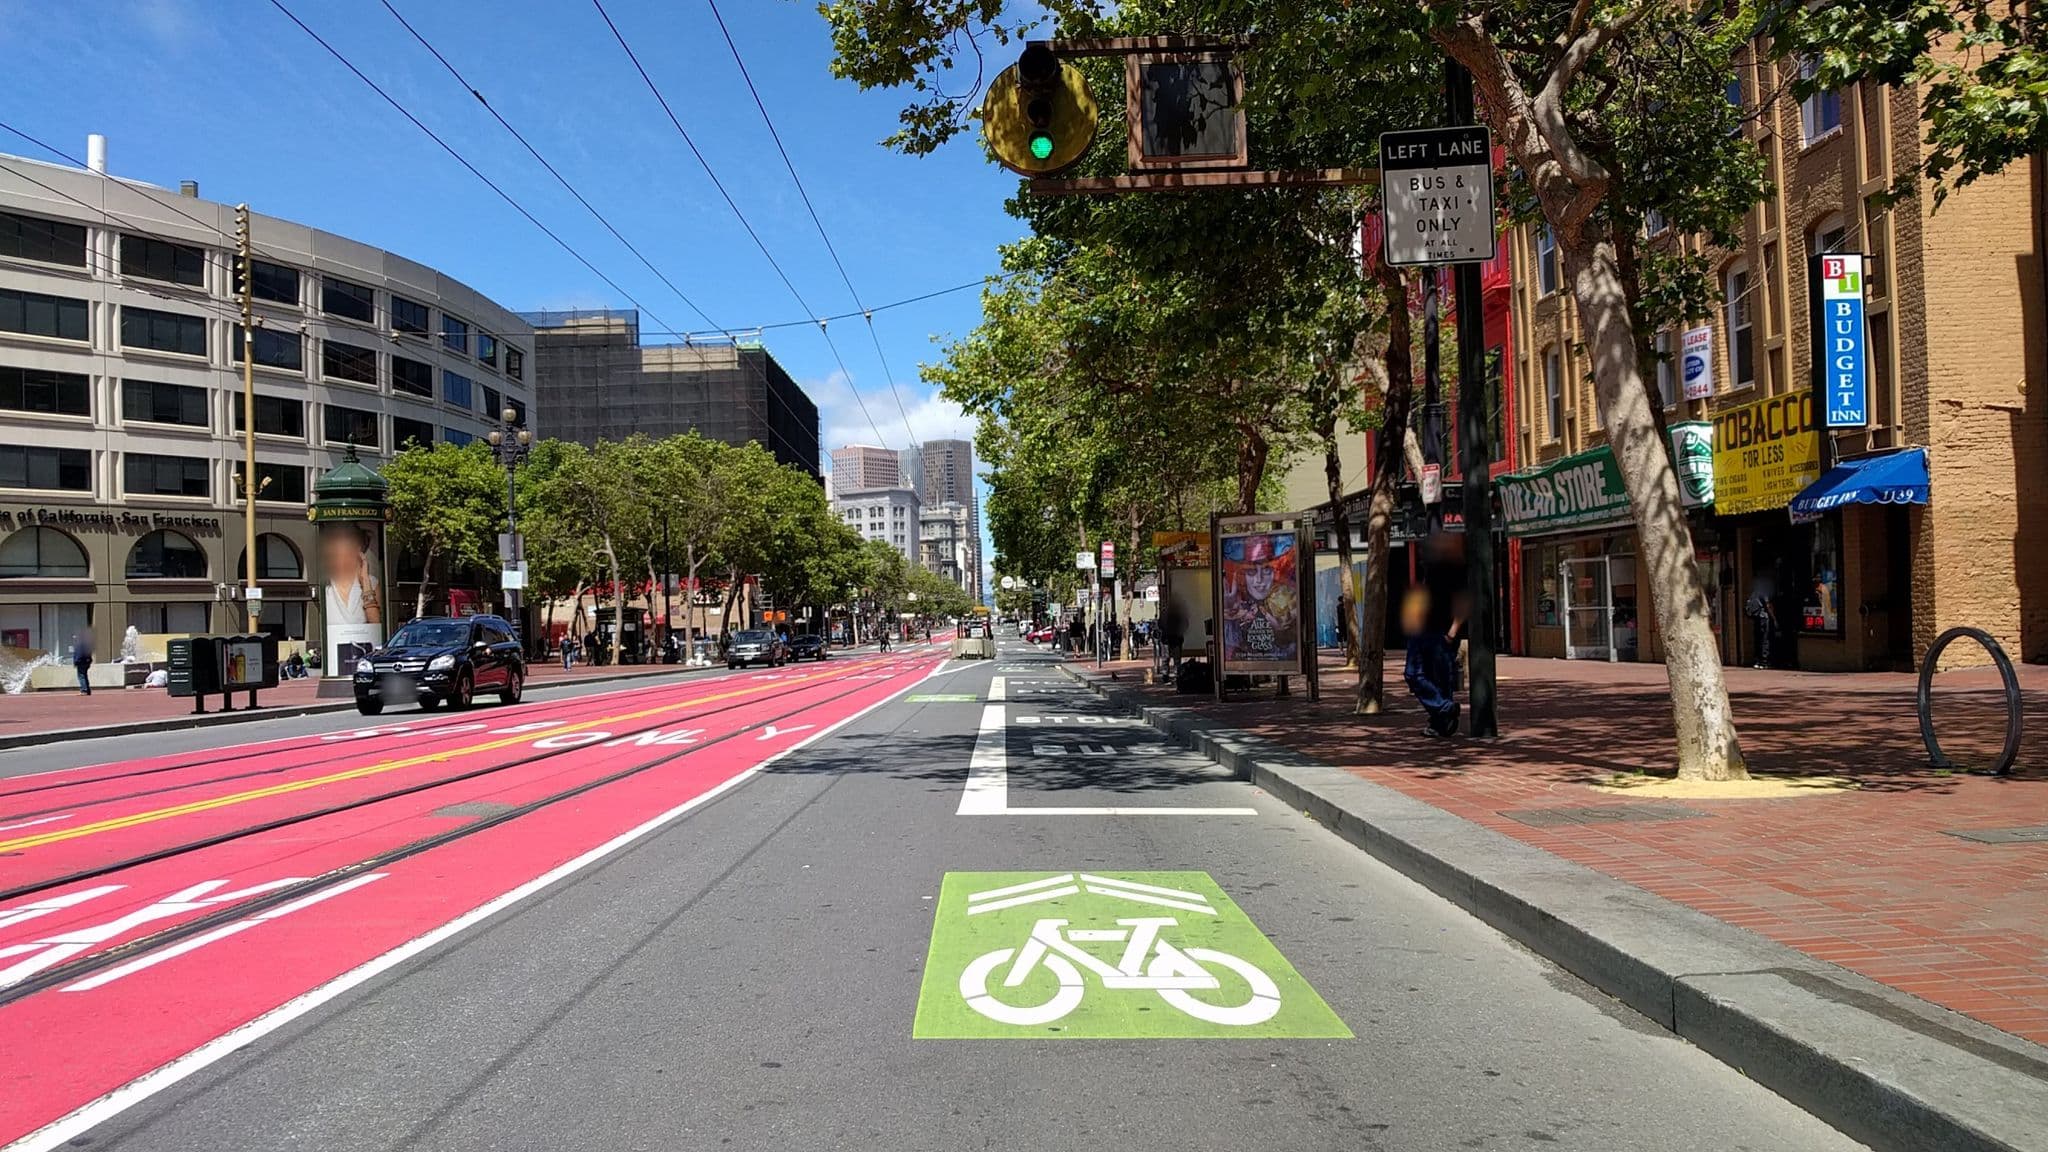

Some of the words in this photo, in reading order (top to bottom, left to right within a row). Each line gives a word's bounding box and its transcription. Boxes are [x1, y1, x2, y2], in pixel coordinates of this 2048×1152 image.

[1387, 143, 1428, 160] LEFT
[1438, 139, 1484, 157] LANE
[1409, 176, 1446, 191] BUS
[1455, 174, 1465, 188] &
[1419, 195, 1460, 212] TAXI
[1416, 217, 1462, 233] ONLY
[1425, 239, 1435, 247] AT
[1441, 238, 1458, 247] ALL
[1428, 251, 1455, 259] TIMES
[1687, 332, 1708, 345] LEASE
[1835, 302, 1855, 407] BUDGET
[1713, 392, 1814, 454] TOBACCO
[1831, 409, 1862, 423] INN
[1743, 449, 1760, 469] FOR
[1762, 444, 1785, 466] LESS
[1763, 466, 1785, 478] KNIVES
[1499, 478, 1556, 522] DOLLAR
[1554, 461, 1609, 514] STORE
[1798, 494, 1840, 510] BUDGET
[153, 512, 219, 528] Francisco
[323, 508, 337, 517] SAN
[337, 508, 378, 517] FRANCISCO
[1250, 619, 1273, 630] ALICE
[1247, 632, 1275, 643] LOOKING
[1251, 641, 1273, 651] GLASS
[532, 723, 815, 750] ONLY
